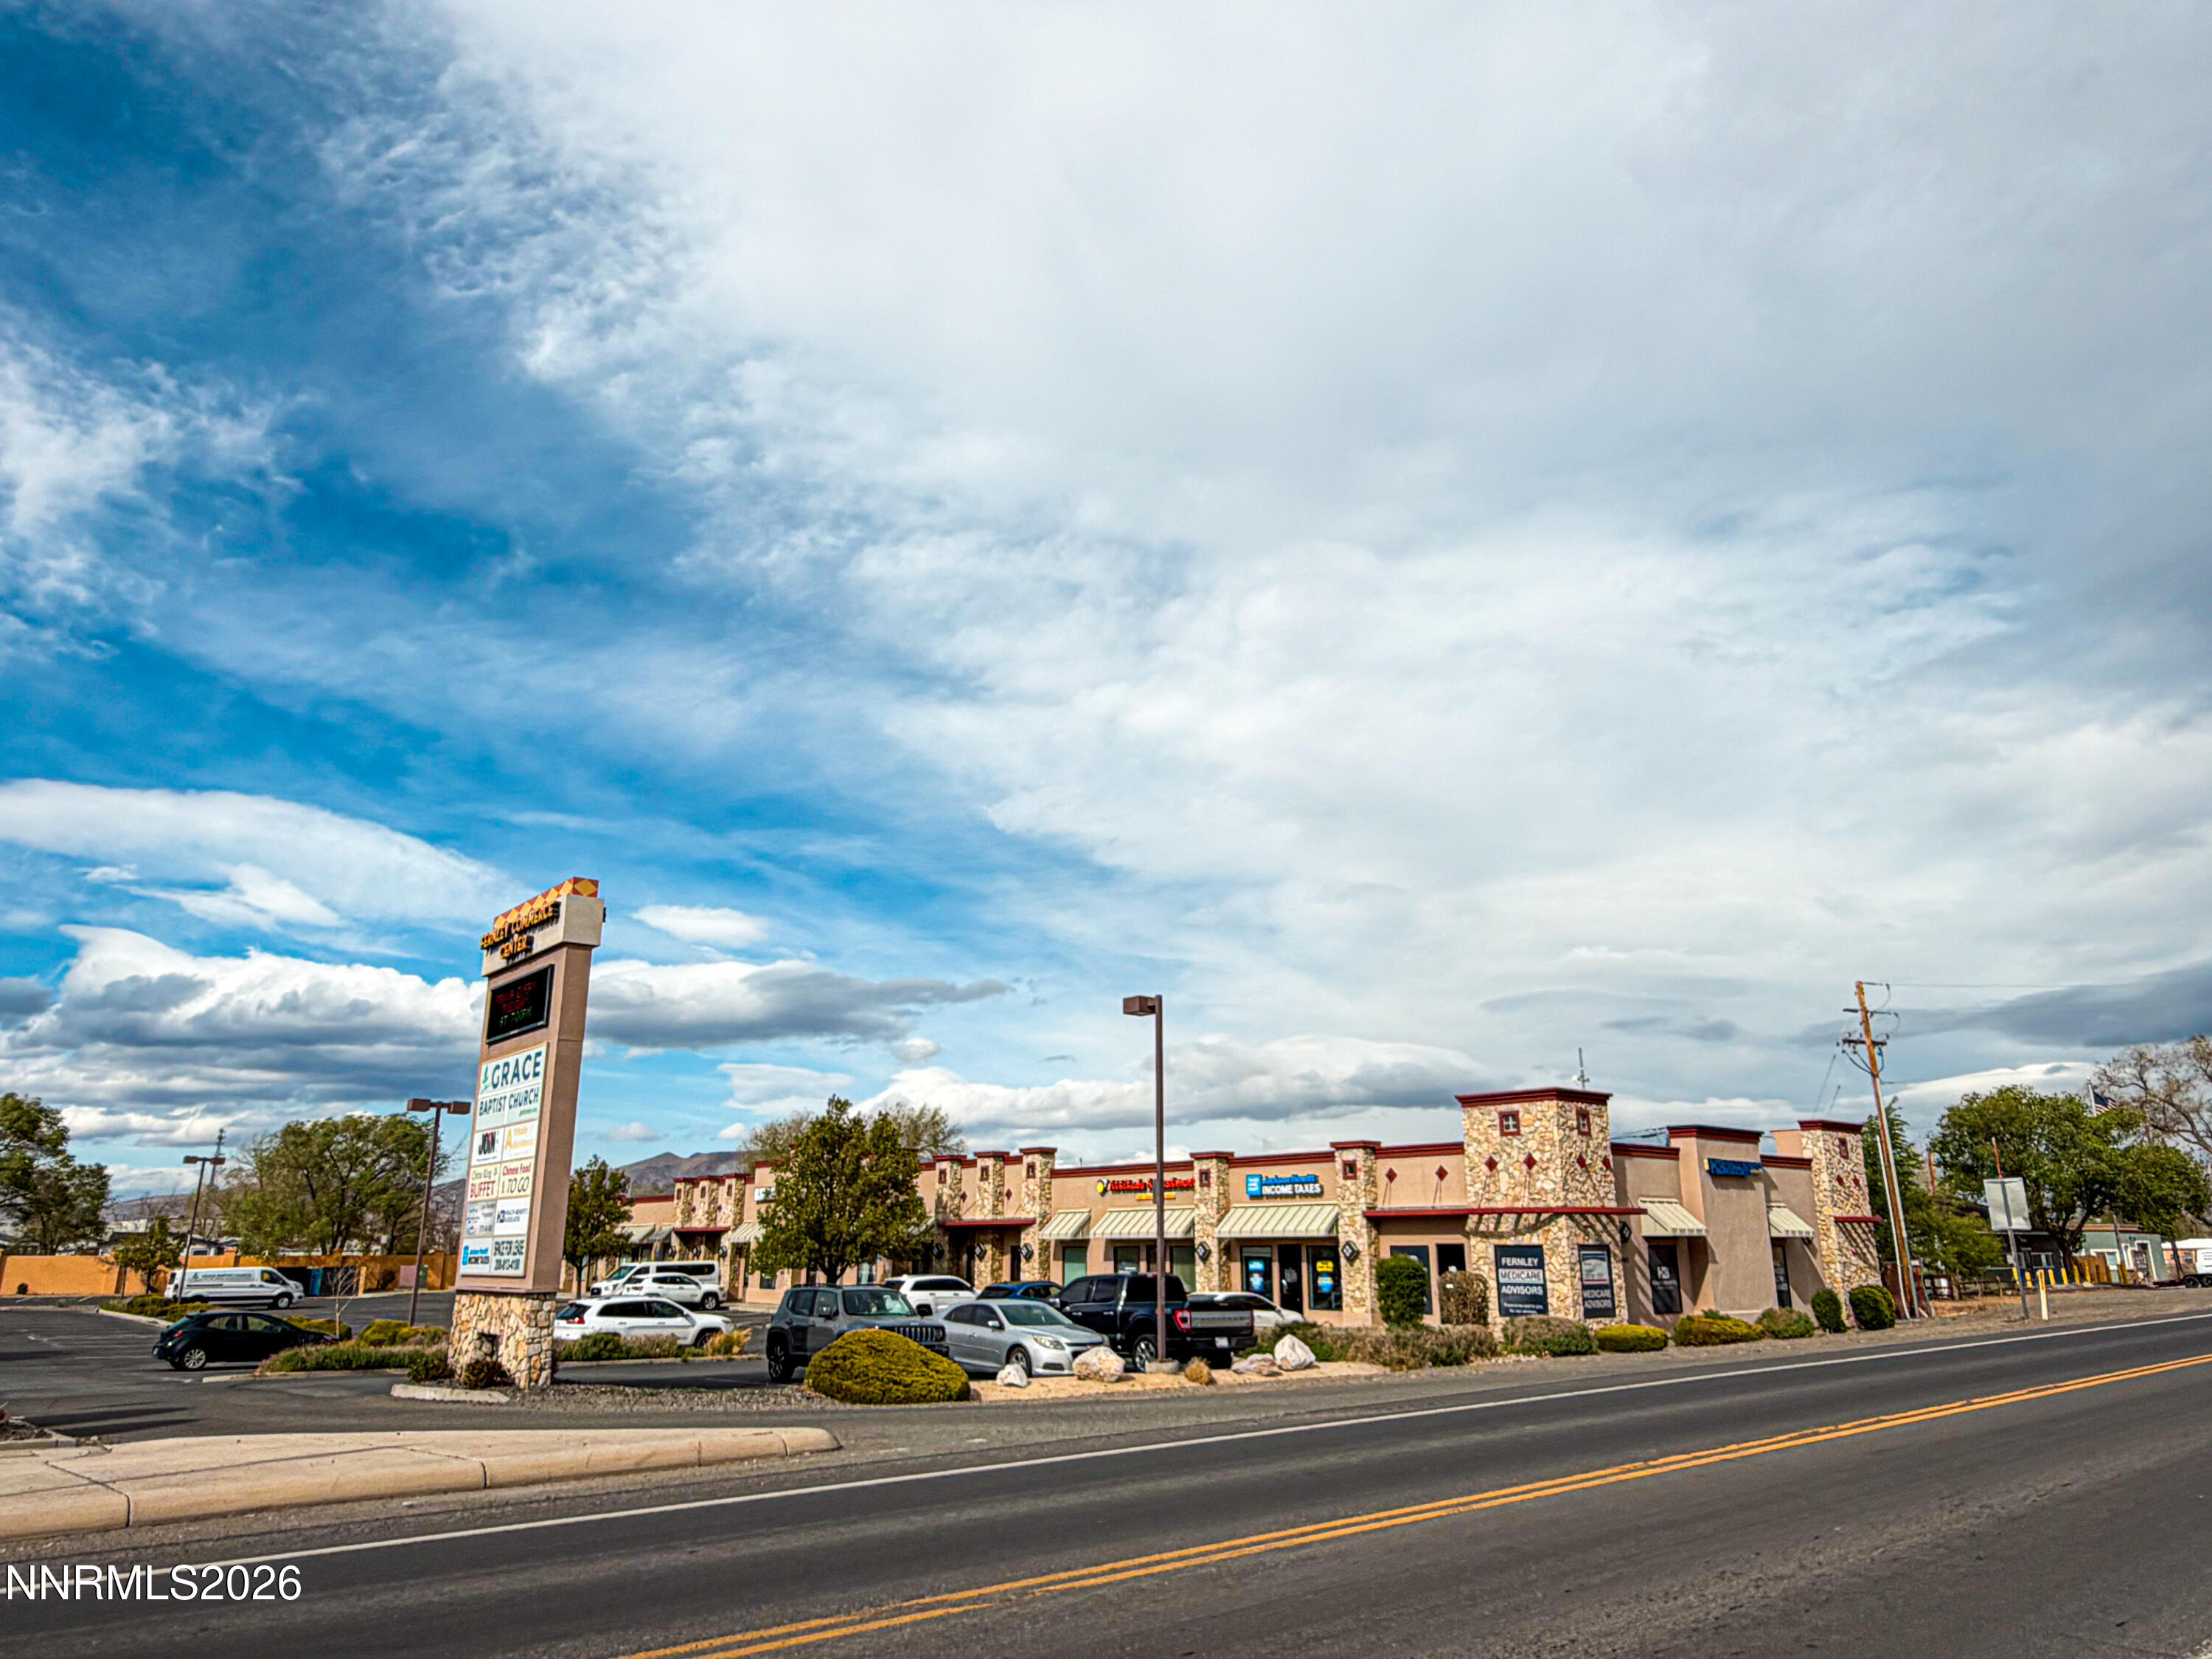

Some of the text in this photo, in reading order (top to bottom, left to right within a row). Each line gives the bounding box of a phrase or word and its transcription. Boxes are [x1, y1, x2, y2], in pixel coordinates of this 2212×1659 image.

[491, 1051, 542, 1089] GRACE
[479, 1096, 507, 1116] BAPTIST
[508, 1087, 539, 1109] CHURCH
[470, 1181, 495, 1197] BUFFET
[507, 1178, 517, 1194] TO
[518, 1176, 529, 1193] GO
[1262, 1184, 1293, 1194] INCOME
[1294, 1183, 1321, 1194] TAXES
[1501, 1257, 1538, 1267] FERNLEY
[1500, 1270, 1541, 1281] MEDICARE
[1501, 1285, 1543, 1295] ADVISORS
